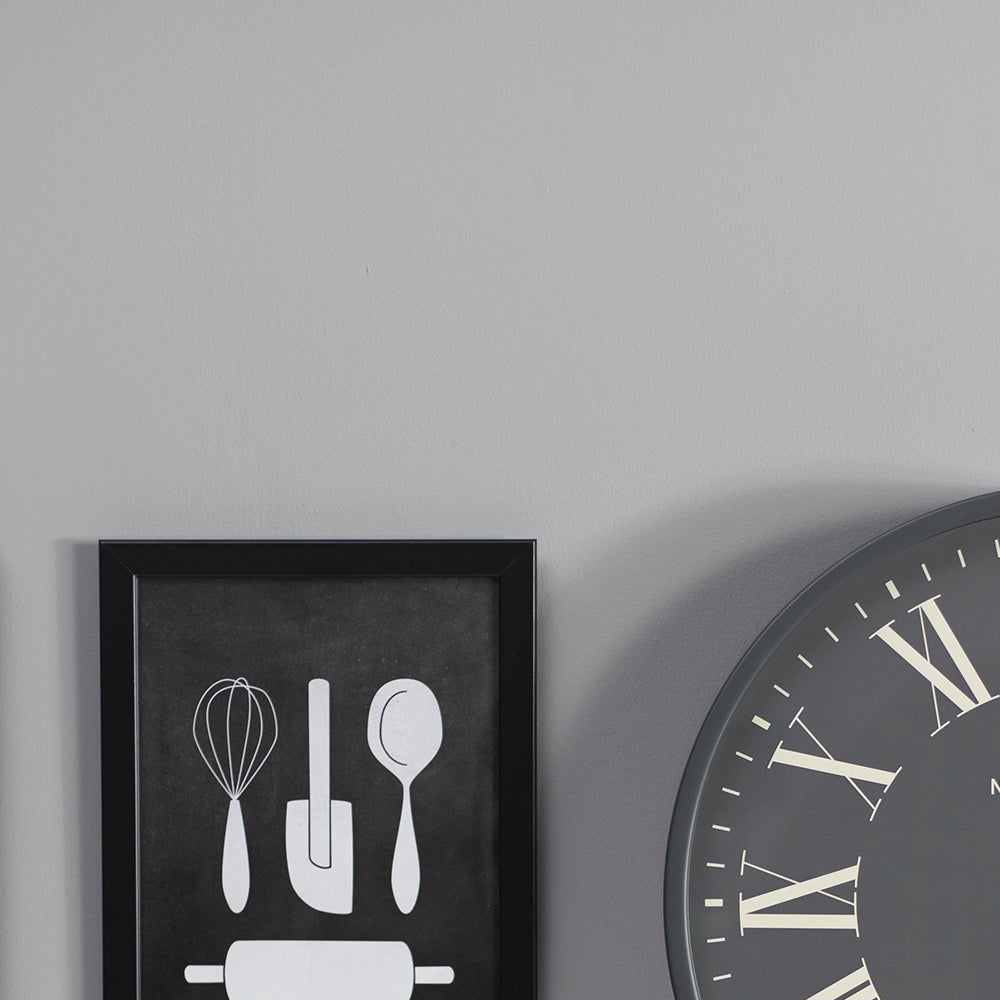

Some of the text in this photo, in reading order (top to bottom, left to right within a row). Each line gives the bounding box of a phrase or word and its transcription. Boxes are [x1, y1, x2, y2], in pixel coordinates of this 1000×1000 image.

[869, 594, 1000, 737] XI
[768, 707, 902, 821] X
[739, 850, 861, 937] IX
